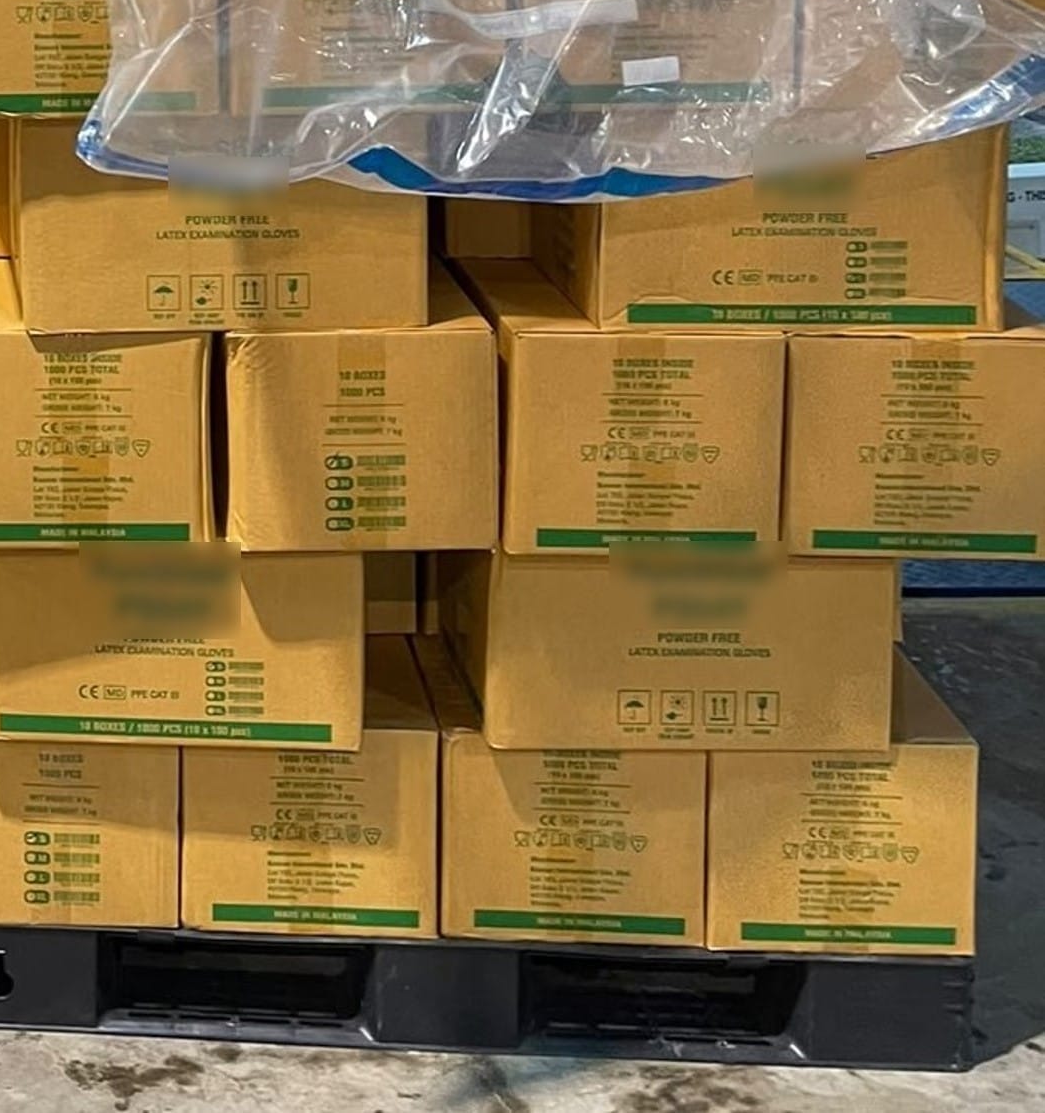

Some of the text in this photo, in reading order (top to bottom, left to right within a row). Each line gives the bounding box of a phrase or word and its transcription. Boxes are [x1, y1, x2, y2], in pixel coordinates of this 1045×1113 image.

[185, 215, 270, 225] POWDER FREE
[762, 213, 849, 223] POWDER FREE
[155, 229, 300, 240] LATEX EXAMINATION GLOVES
[732, 227, 878, 237] LATEX EXAMINATION GLOVES
[43, 365, 120, 375] 1000 PCS TOTAL
[339, 371, 386, 381] 10 BOXES
[340, 387, 386, 397] 1000 PCS
[658, 632, 742, 643] POWDER FREE
[95, 645, 235, 657] LATEX EXAMINATION GLOVES
[628, 647, 771, 658] LATEX EXAMINATION GLOVES
[79, 684, 99, 699] CE
[130, 690, 169, 699] PPE CAT
[79, 721, 91, 731] 10
[93, 721, 126, 732] BOXES
[137, 722, 160, 733] 1000
[162, 723, 182, 733] PCS
[210, 726, 229, 736] 100
